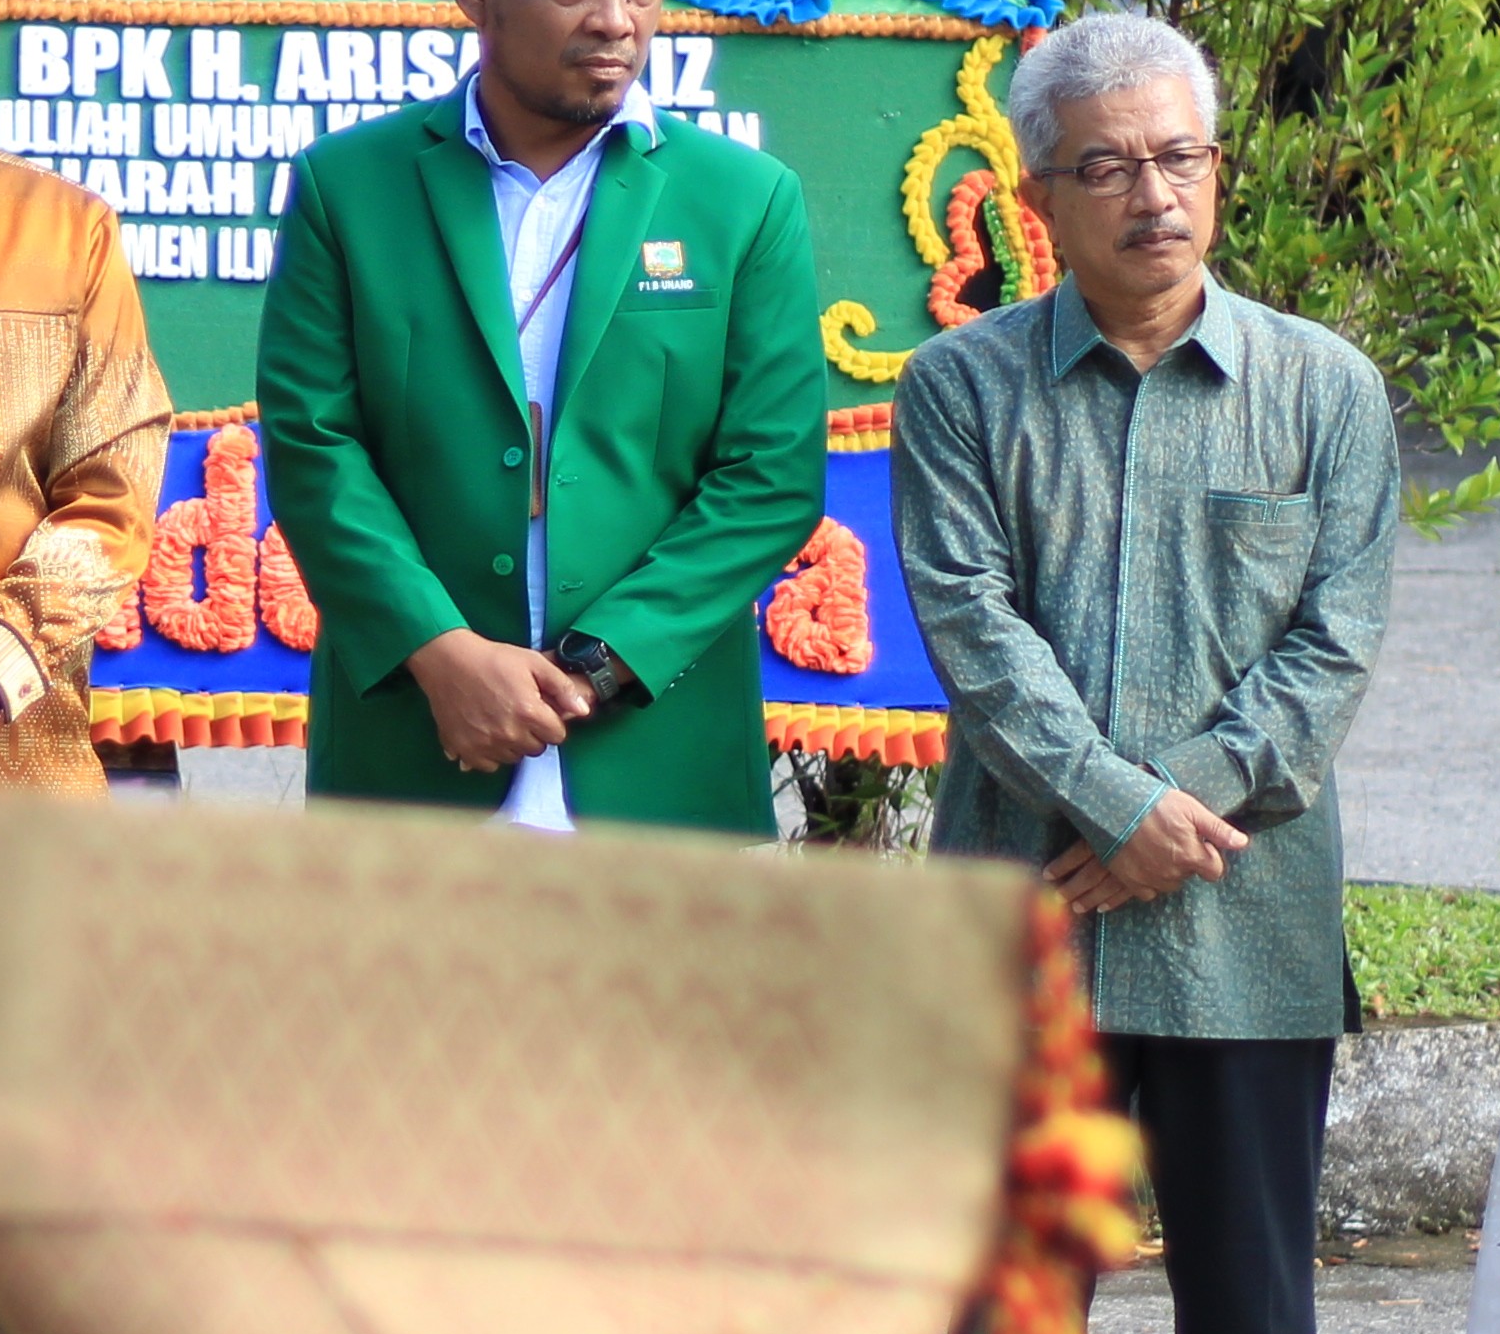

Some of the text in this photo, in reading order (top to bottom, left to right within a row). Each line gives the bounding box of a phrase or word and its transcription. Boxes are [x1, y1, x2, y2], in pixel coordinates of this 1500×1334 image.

[19, 25, 172, 98] BPK
[190, 29, 260, 101] H.
[153, 103, 316, 158] UMUM
